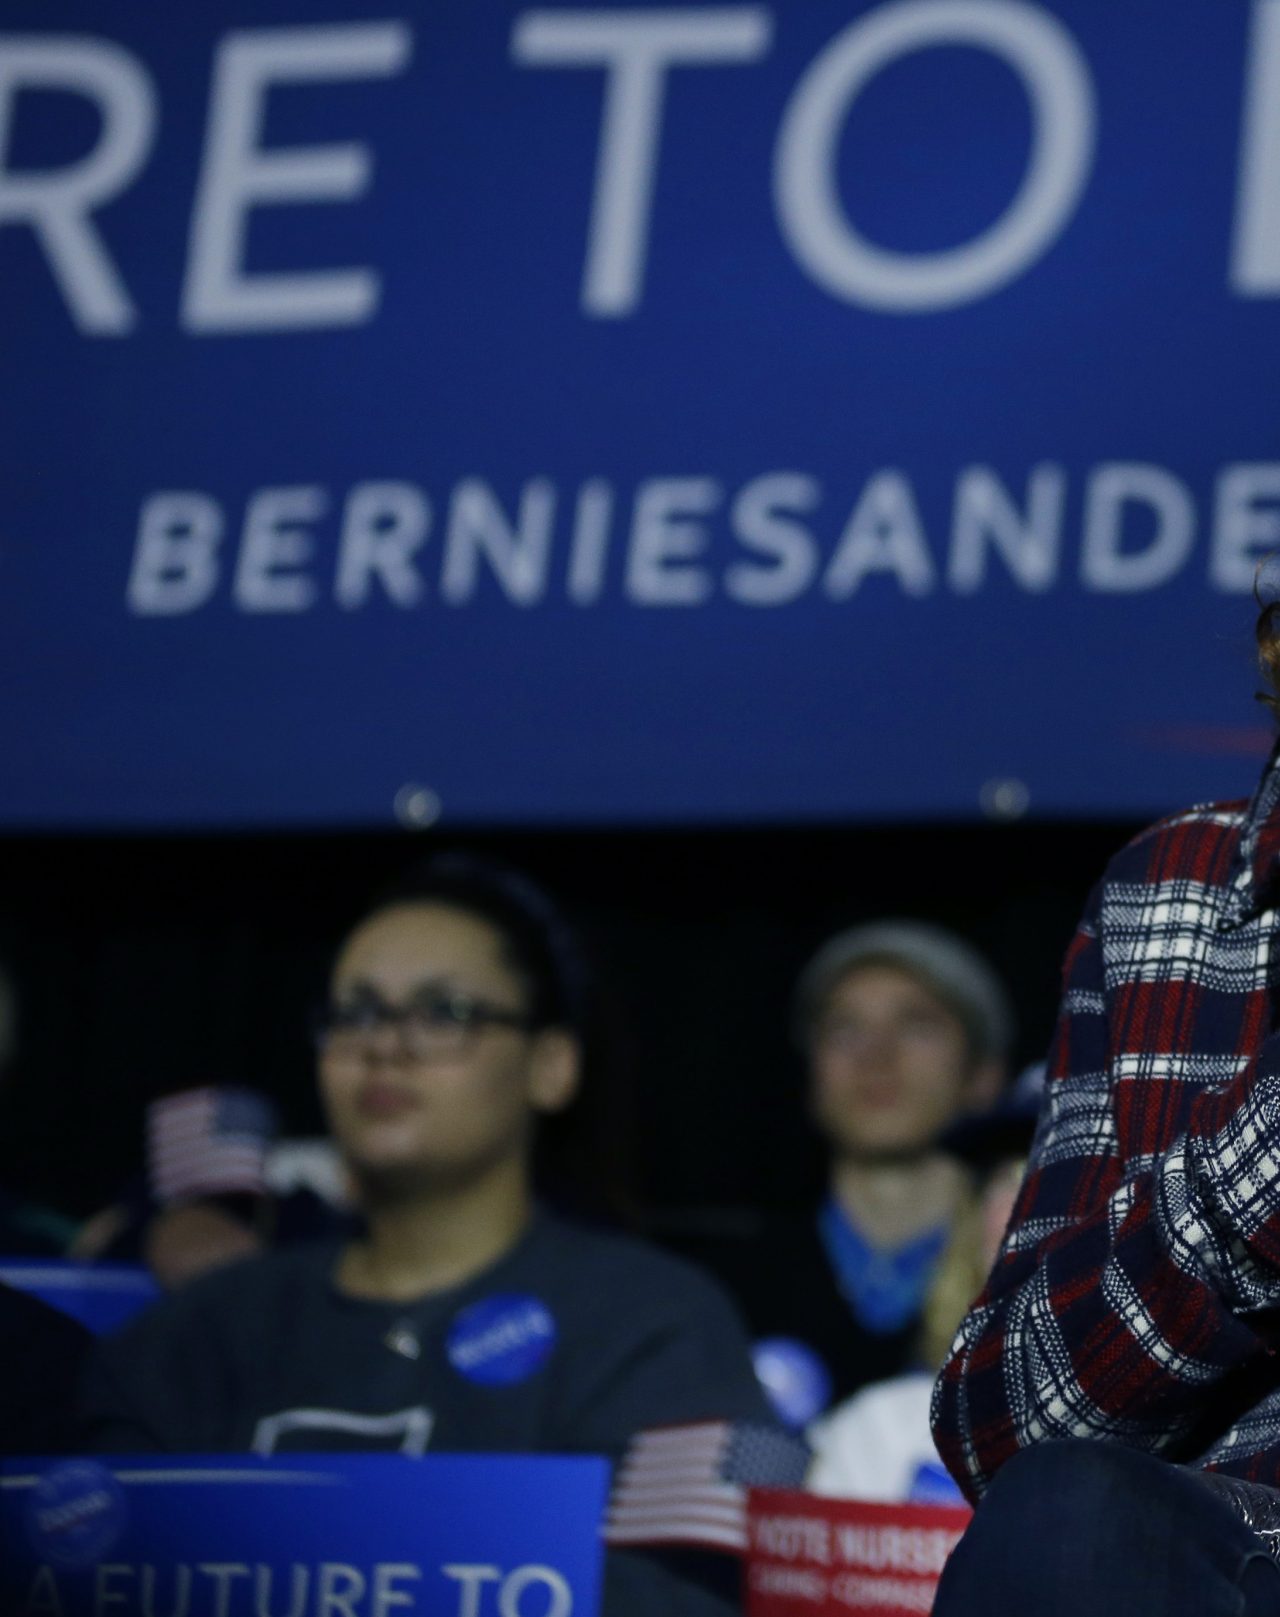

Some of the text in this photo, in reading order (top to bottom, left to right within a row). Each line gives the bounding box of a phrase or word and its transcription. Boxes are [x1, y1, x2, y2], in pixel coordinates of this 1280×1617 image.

[0, 22, 412, 336] RE
[510, 0, 1100, 316] TO
[94, 1562, 420, 1617] FUTURE
[440, 1562, 574, 1617] TO
